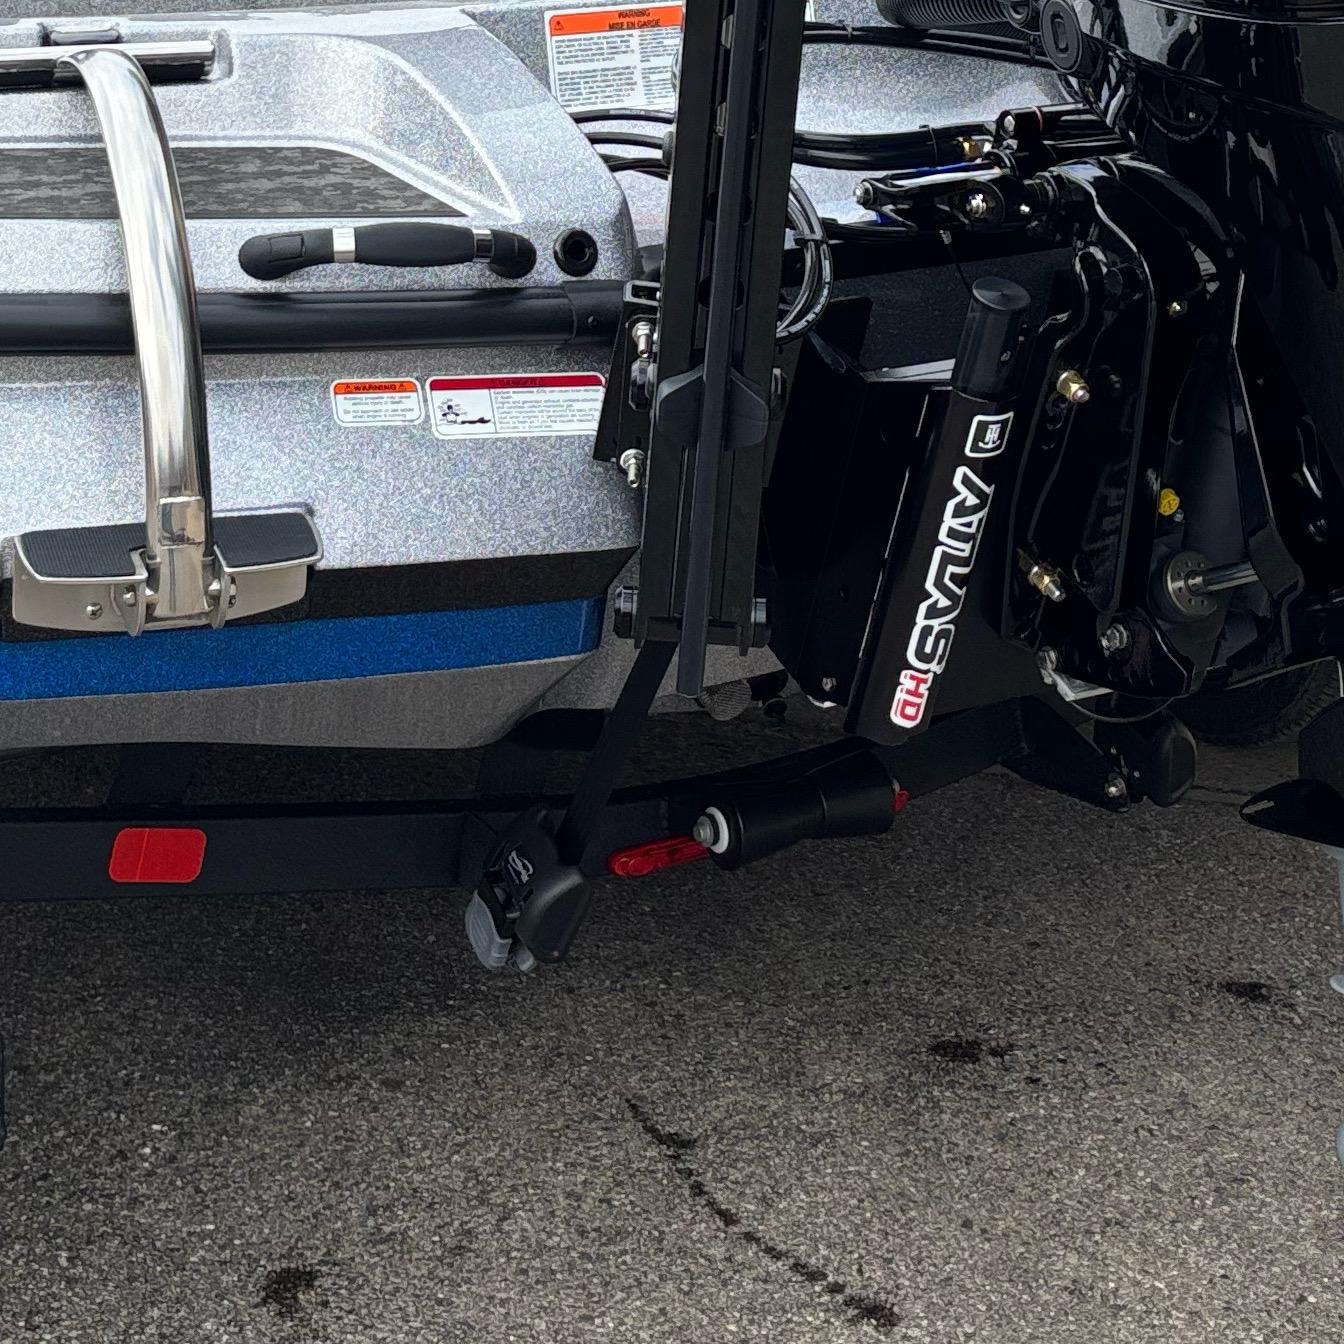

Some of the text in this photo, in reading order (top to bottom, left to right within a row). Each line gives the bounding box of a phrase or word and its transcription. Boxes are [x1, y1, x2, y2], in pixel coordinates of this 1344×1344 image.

[353, 383, 397, 392] WARNING
[890, 465, 995, 729] ATLAS HD
